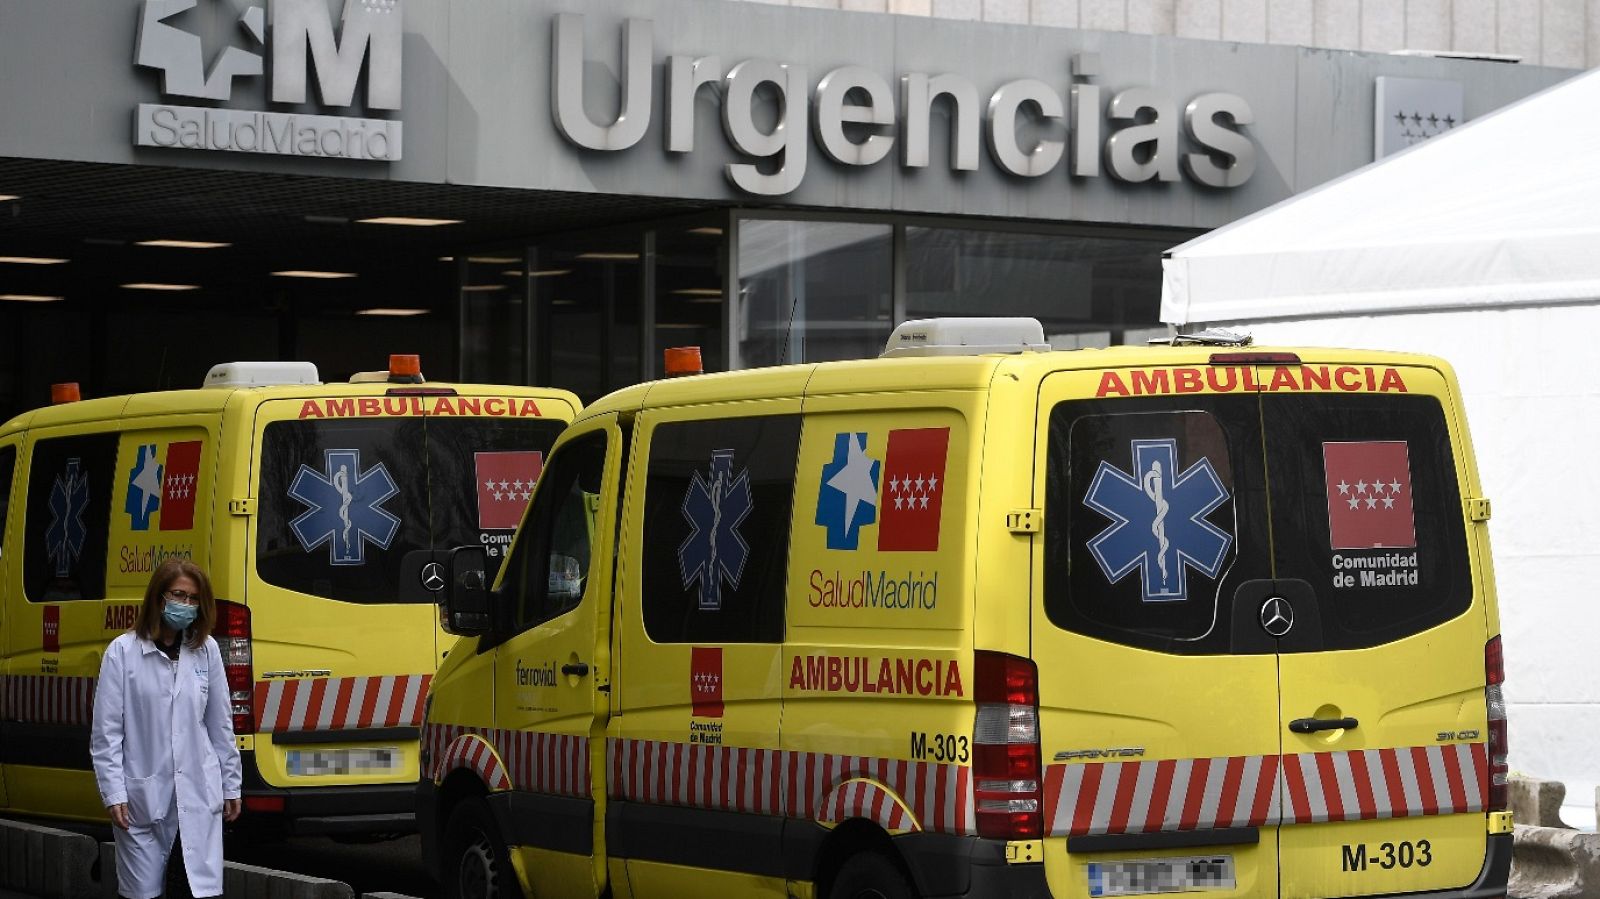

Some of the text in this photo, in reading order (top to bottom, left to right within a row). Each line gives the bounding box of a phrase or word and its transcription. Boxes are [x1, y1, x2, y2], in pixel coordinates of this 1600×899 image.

[551, 12, 1257, 196] Urgencias
[150, 108, 393, 160] SaludMadrid
[1096, 365, 1409, 398] AMBULANCIA
[299, 397, 542, 419] AMBULANCIA
[1332, 552, 1418, 569] Comunidad
[808, 570, 938, 610] SaludMadrid
[1333, 569, 1418, 588] de Madrid
[516, 659, 557, 687] ferrovial
[790, 655, 965, 697] AMBULANCIA
[911, 732, 969, 764] M-303
[1053, 748, 1145, 761] SPRINTER
[1341, 840, 1433, 872] M-303
